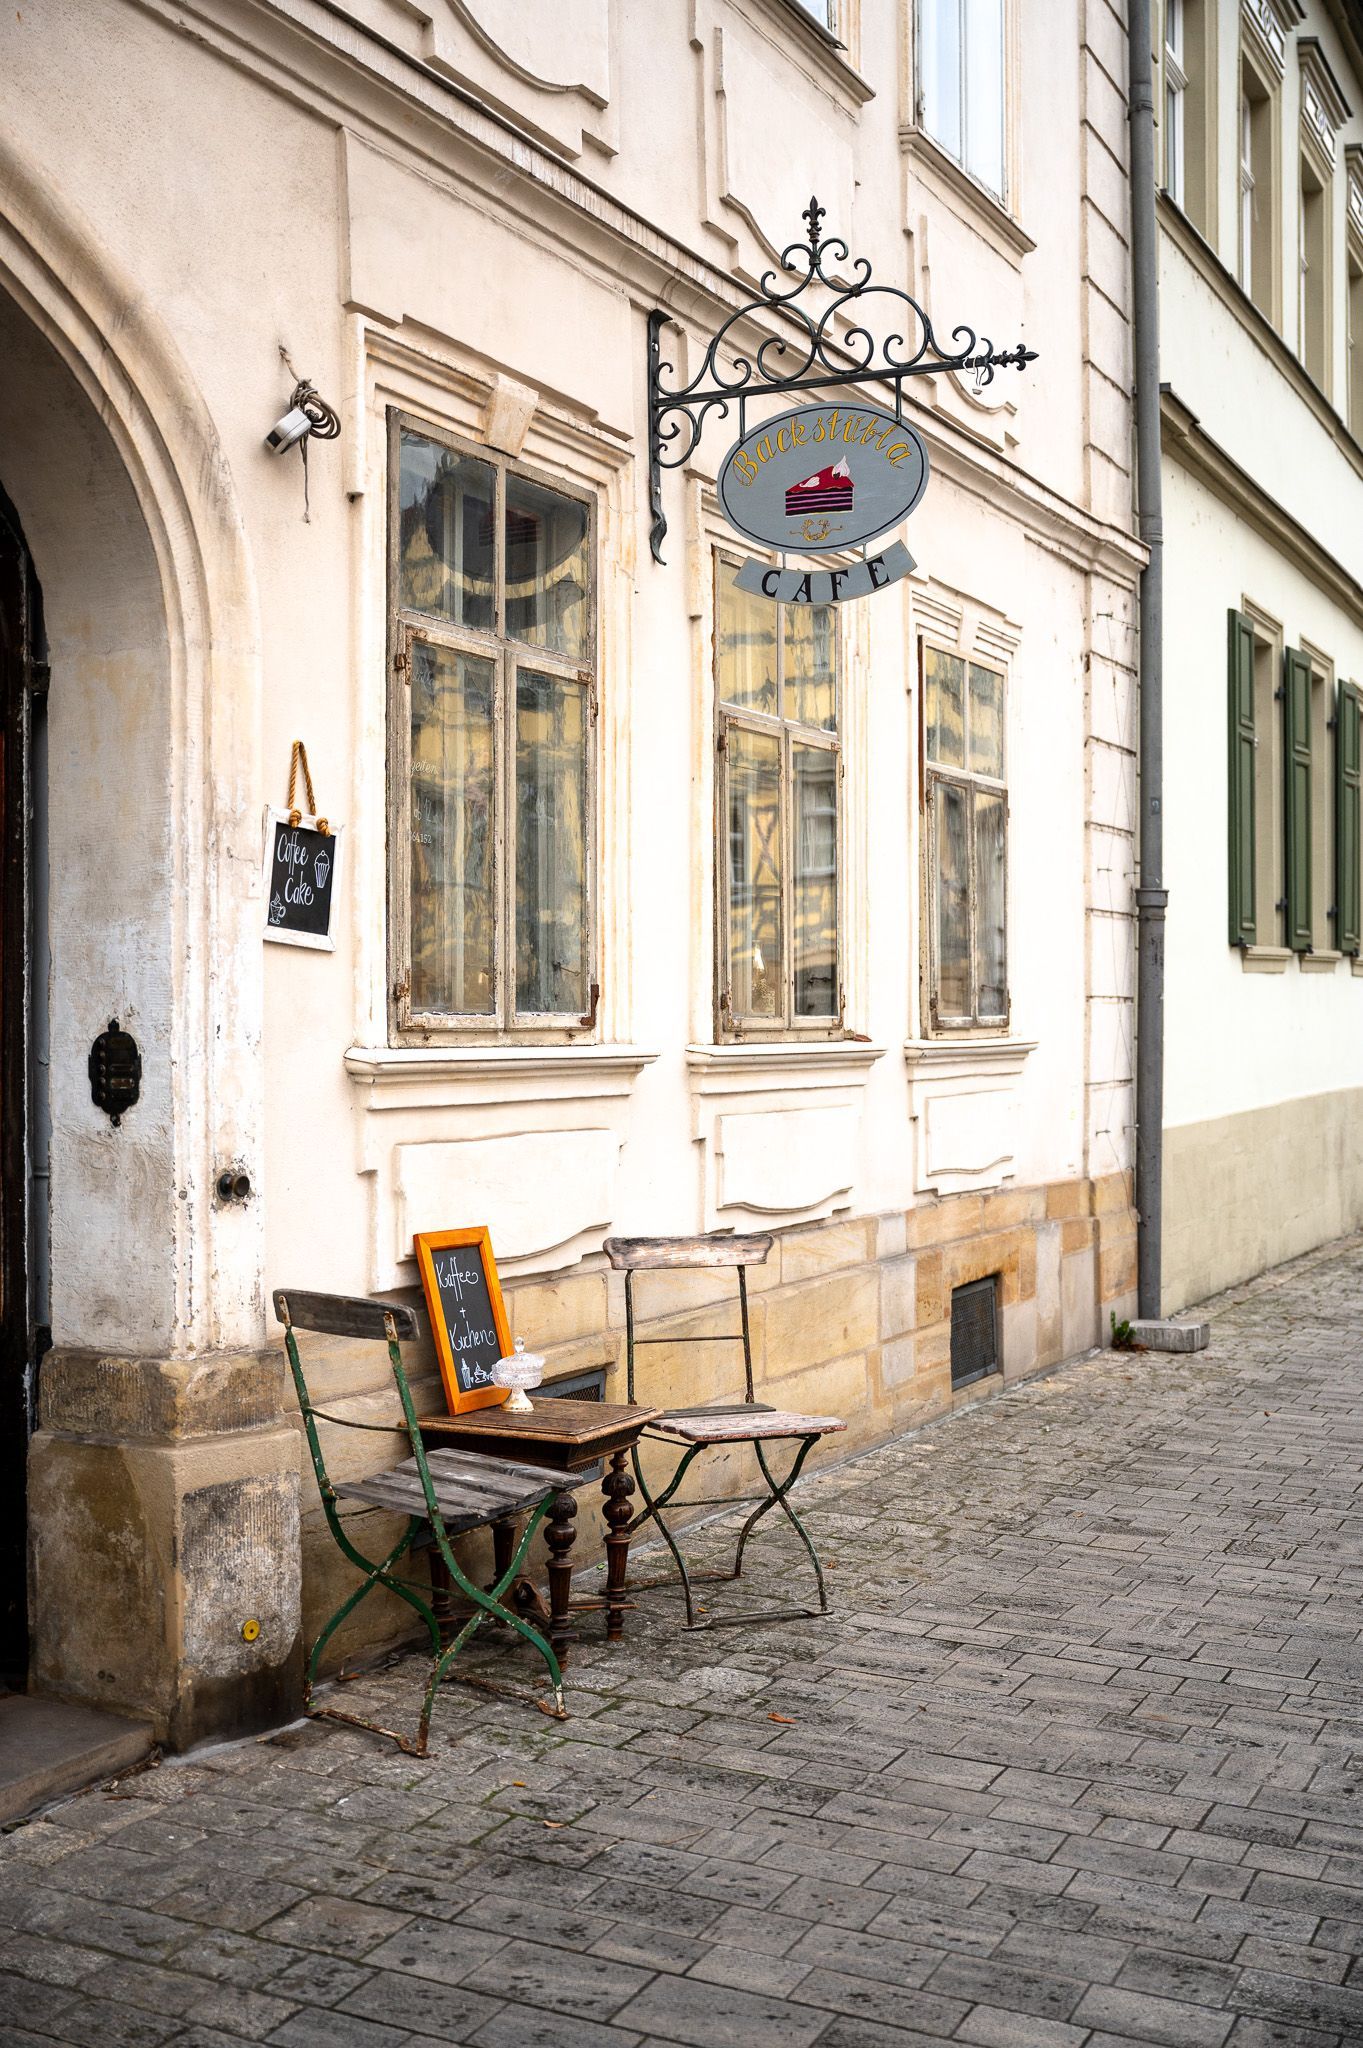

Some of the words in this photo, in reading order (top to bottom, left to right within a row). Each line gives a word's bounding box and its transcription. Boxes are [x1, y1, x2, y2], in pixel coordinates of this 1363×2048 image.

[761, 555, 891, 602] CAFE
[277, 831, 309, 876] Coffee
[284, 871, 314, 906] Cake
[435, 1256, 479, 1302] Kaffee
[449, 1321, 496, 1351] Kuchen
